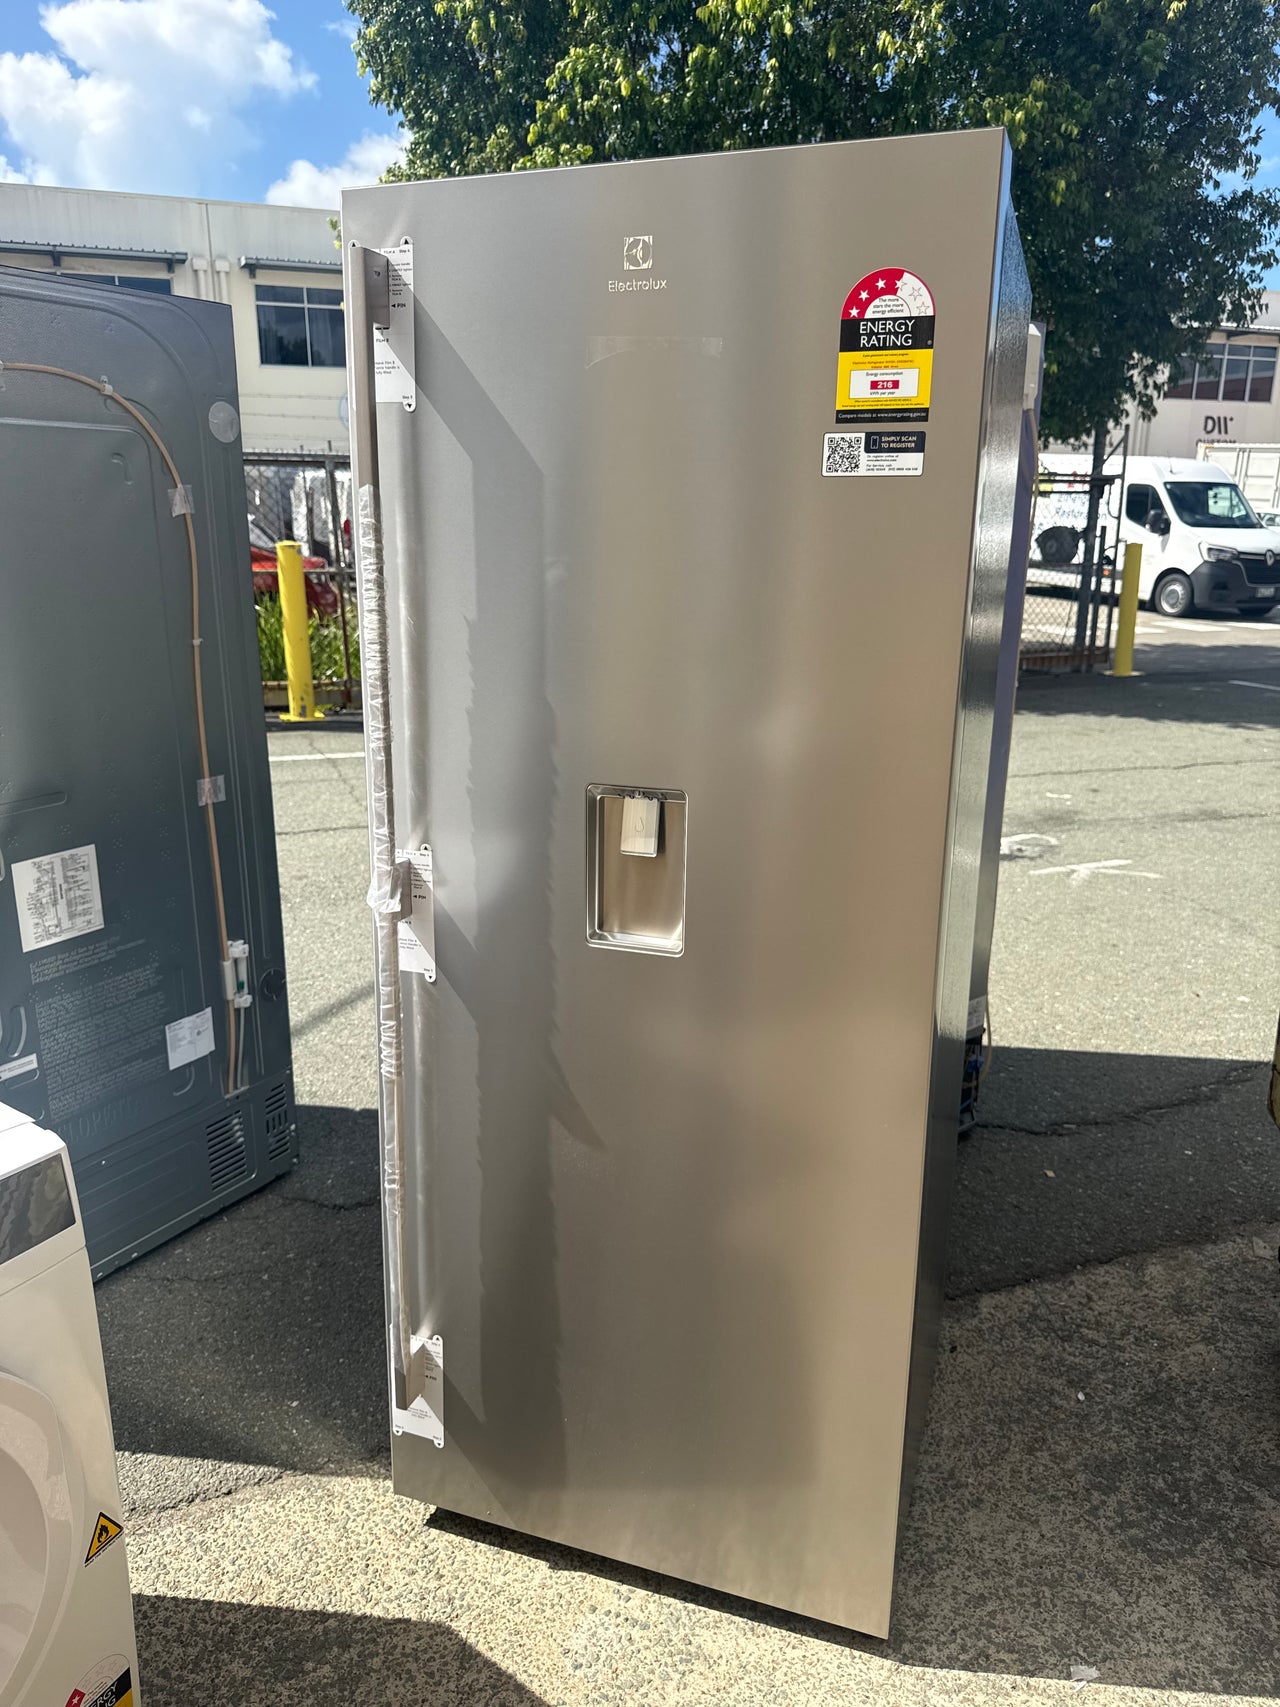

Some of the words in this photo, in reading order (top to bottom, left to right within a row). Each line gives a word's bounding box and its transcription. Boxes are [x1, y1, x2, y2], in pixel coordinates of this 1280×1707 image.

[608, 278, 667, 292] Electrolux
[860, 320, 915, 334] ENERGY
[860, 334, 912, 348] RATING
